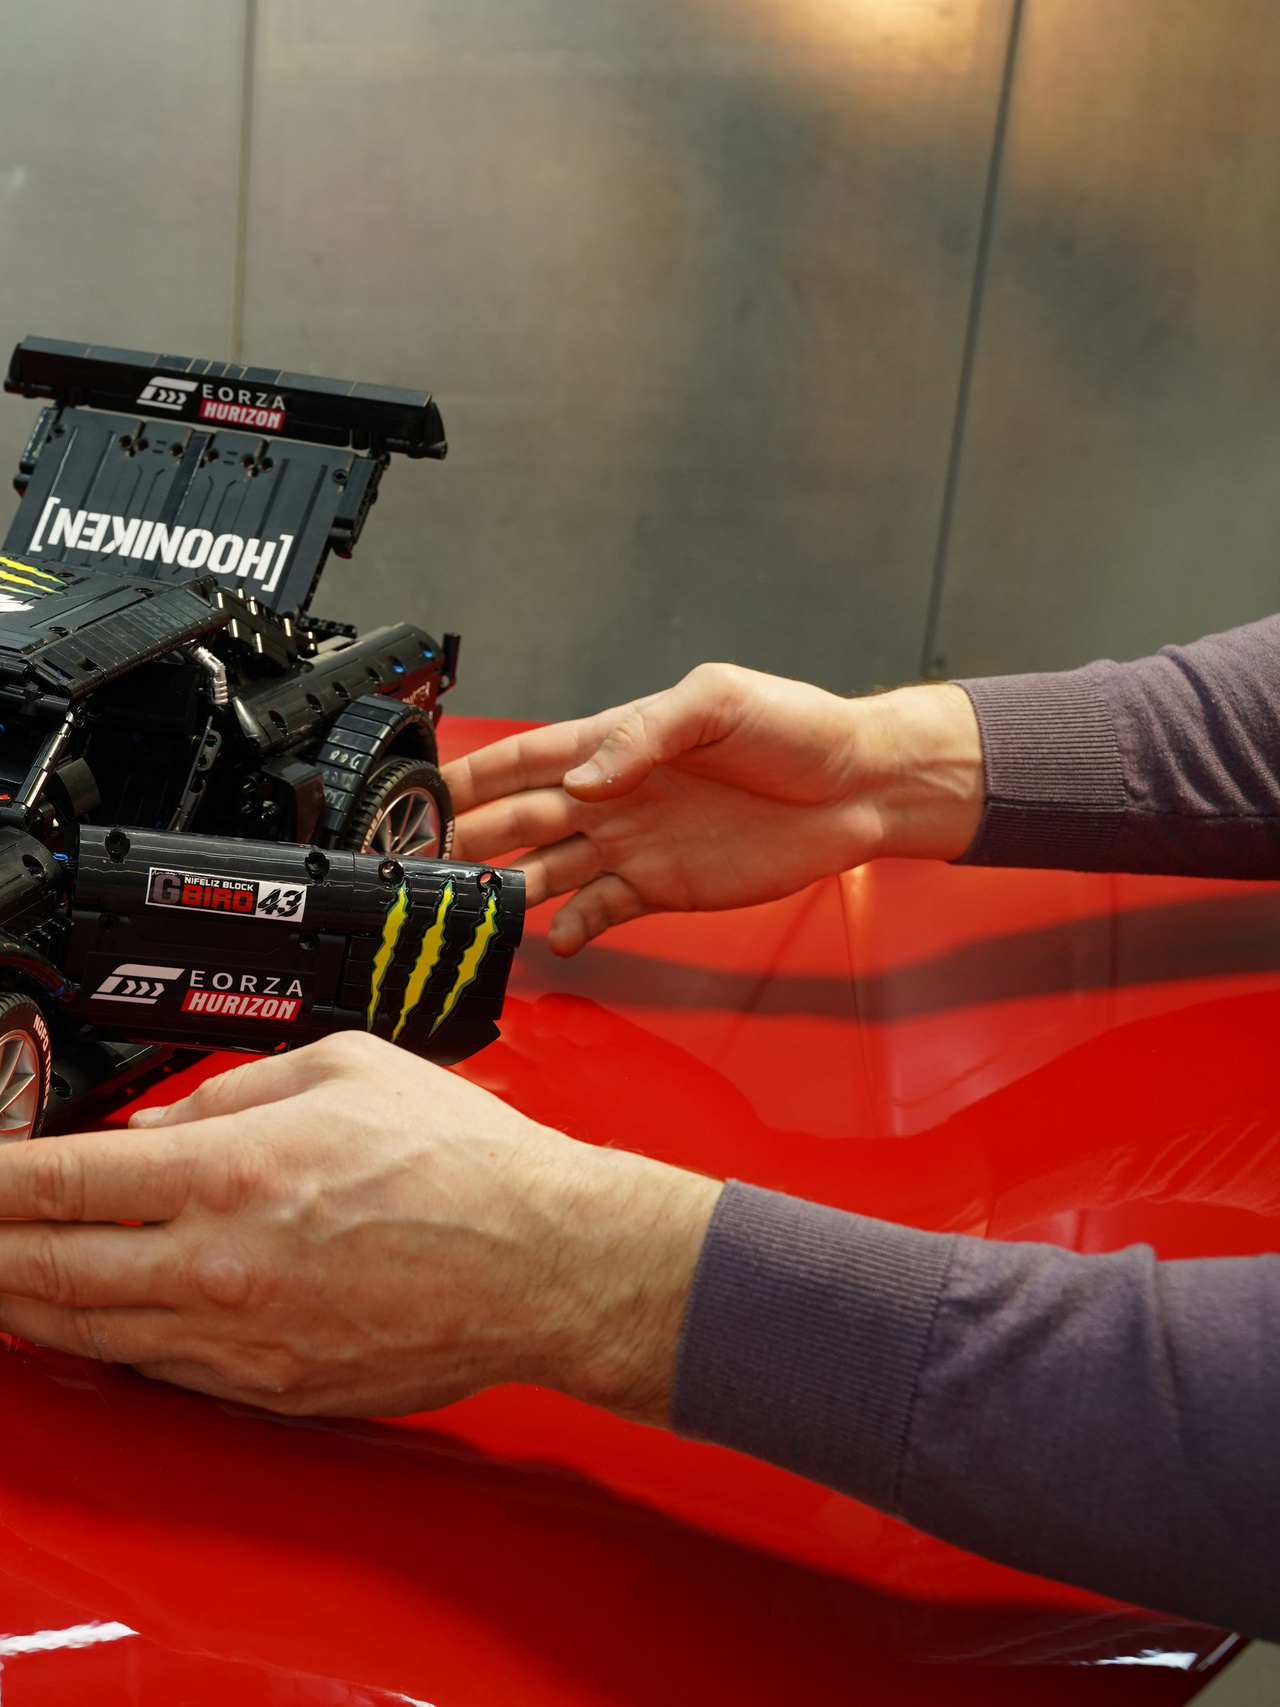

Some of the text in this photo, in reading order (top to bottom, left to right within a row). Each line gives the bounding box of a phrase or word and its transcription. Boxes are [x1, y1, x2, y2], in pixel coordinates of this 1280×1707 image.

[201, 383, 286, 411] EORZA
[203, 404, 282, 430] HURIZON
[184, 876, 255, 892] NIFELIZ BLOCK
[181, 884, 254, 913] BIRD
[257, 888, 306, 918] 43
[189, 969, 304, 997] EORZA
[187, 992, 297, 1020] HURIZON
